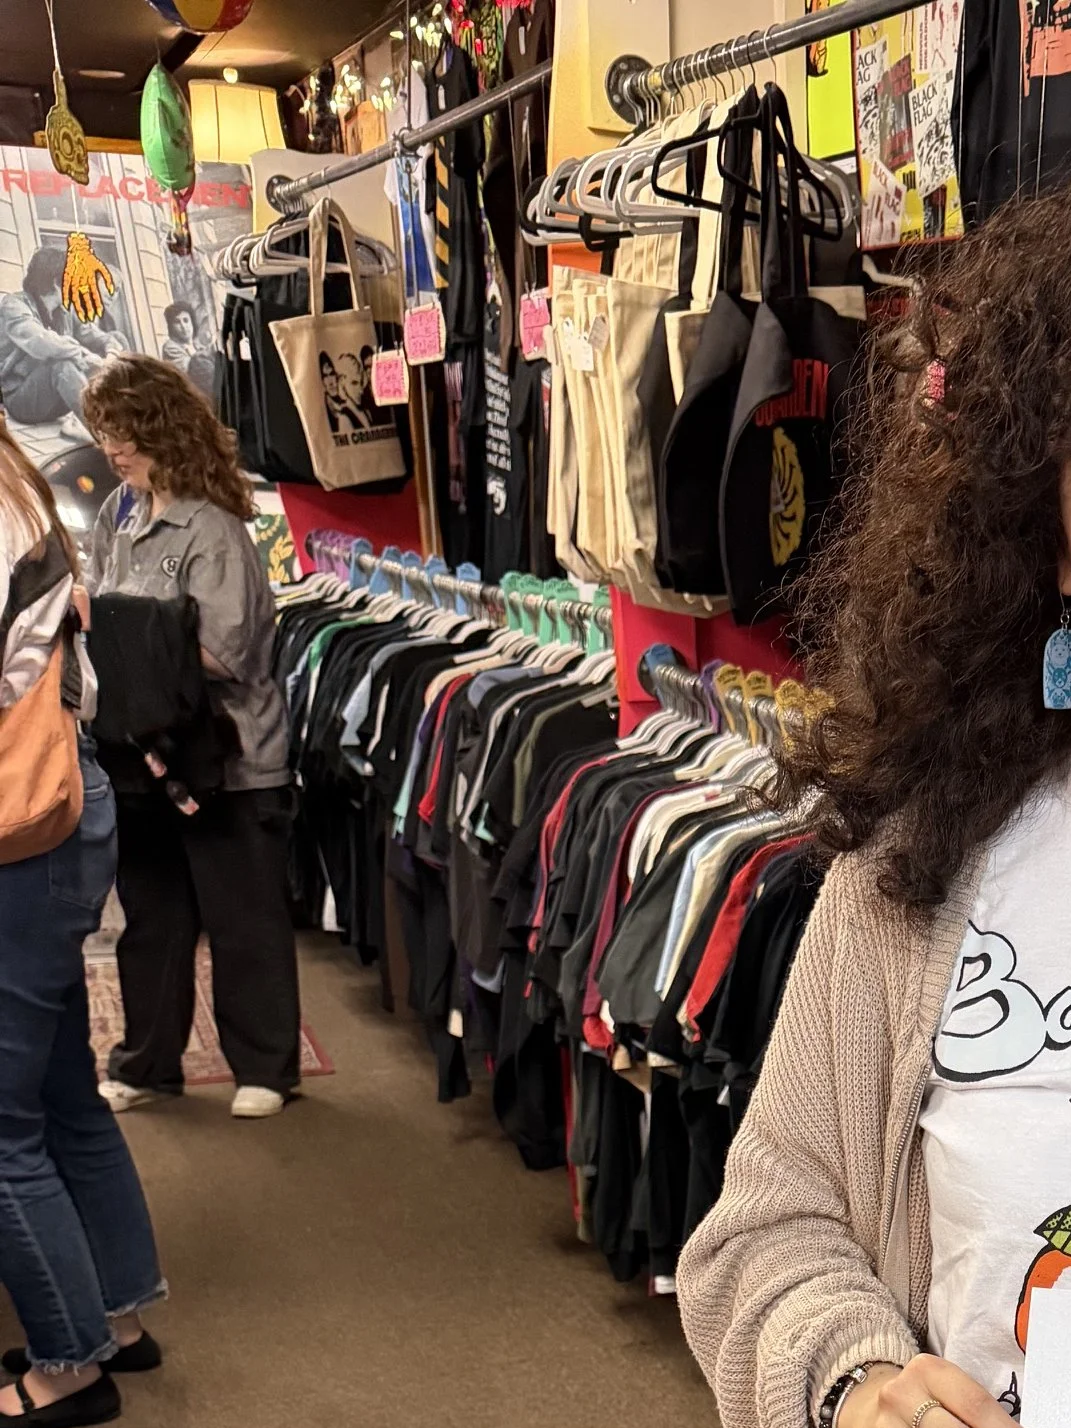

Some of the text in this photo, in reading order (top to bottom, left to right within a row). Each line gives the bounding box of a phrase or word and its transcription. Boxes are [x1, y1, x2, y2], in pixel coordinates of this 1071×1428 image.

[857, 48, 878, 71] ACK
[857, 67, 872, 86] AG
[911, 83, 939, 112] BLACK
[912, 106, 934, 127] FLAG
